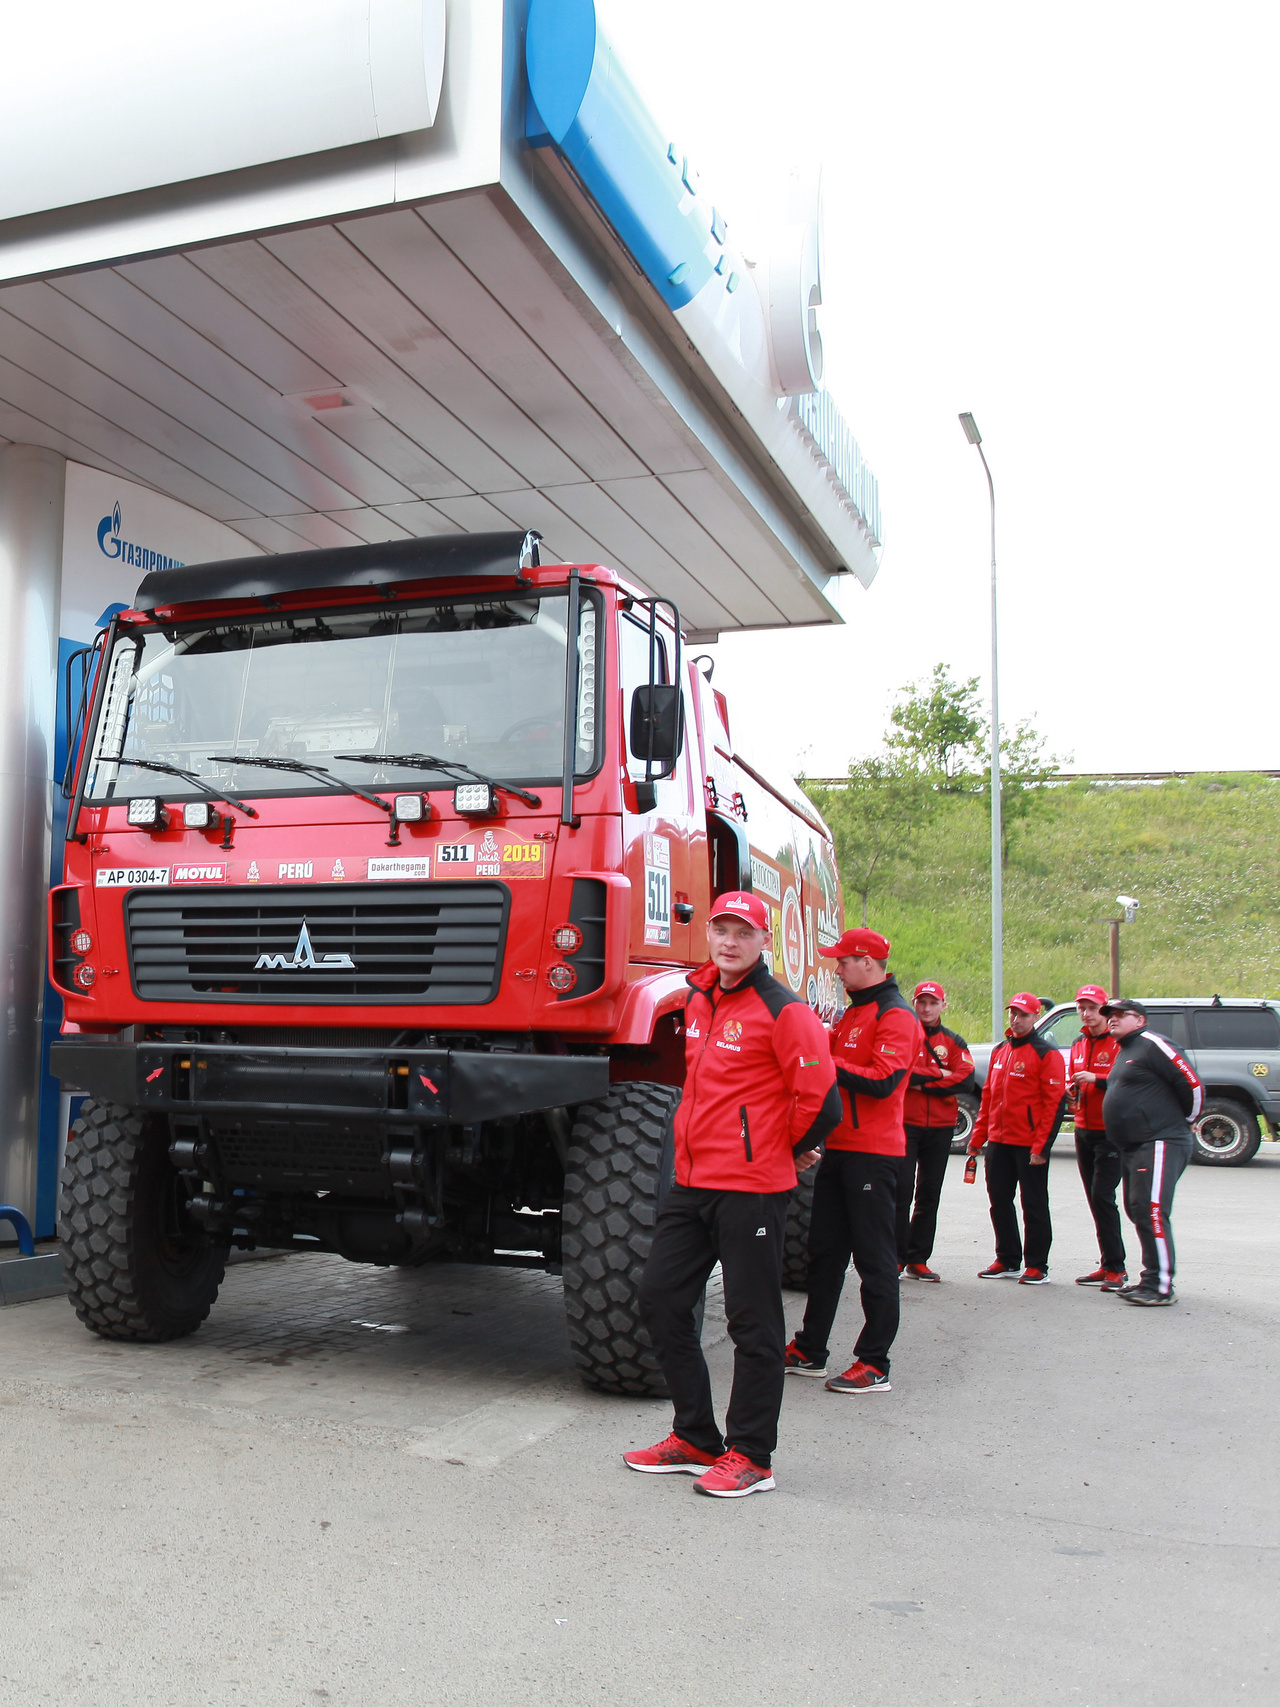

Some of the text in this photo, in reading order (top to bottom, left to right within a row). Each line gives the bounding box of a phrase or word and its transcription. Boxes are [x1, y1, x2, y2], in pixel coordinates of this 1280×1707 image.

[121, 540, 186, 572] ГАЗПРОМ
[441, 845, 469, 862] 511
[478, 851, 500, 863] DAKAR
[503, 844, 541, 862] 2019
[175, 867, 223, 880] MOTUL
[278, 860, 313, 879] PERÚ
[371, 863, 426, 873] Dakarthegame
[476, 862, 501, 876] PERÚ
[107, 870, 167, 884] AP 0304-7
[648, 870, 669, 922] 511
[716, 1040, 741, 1052] BELARUS
